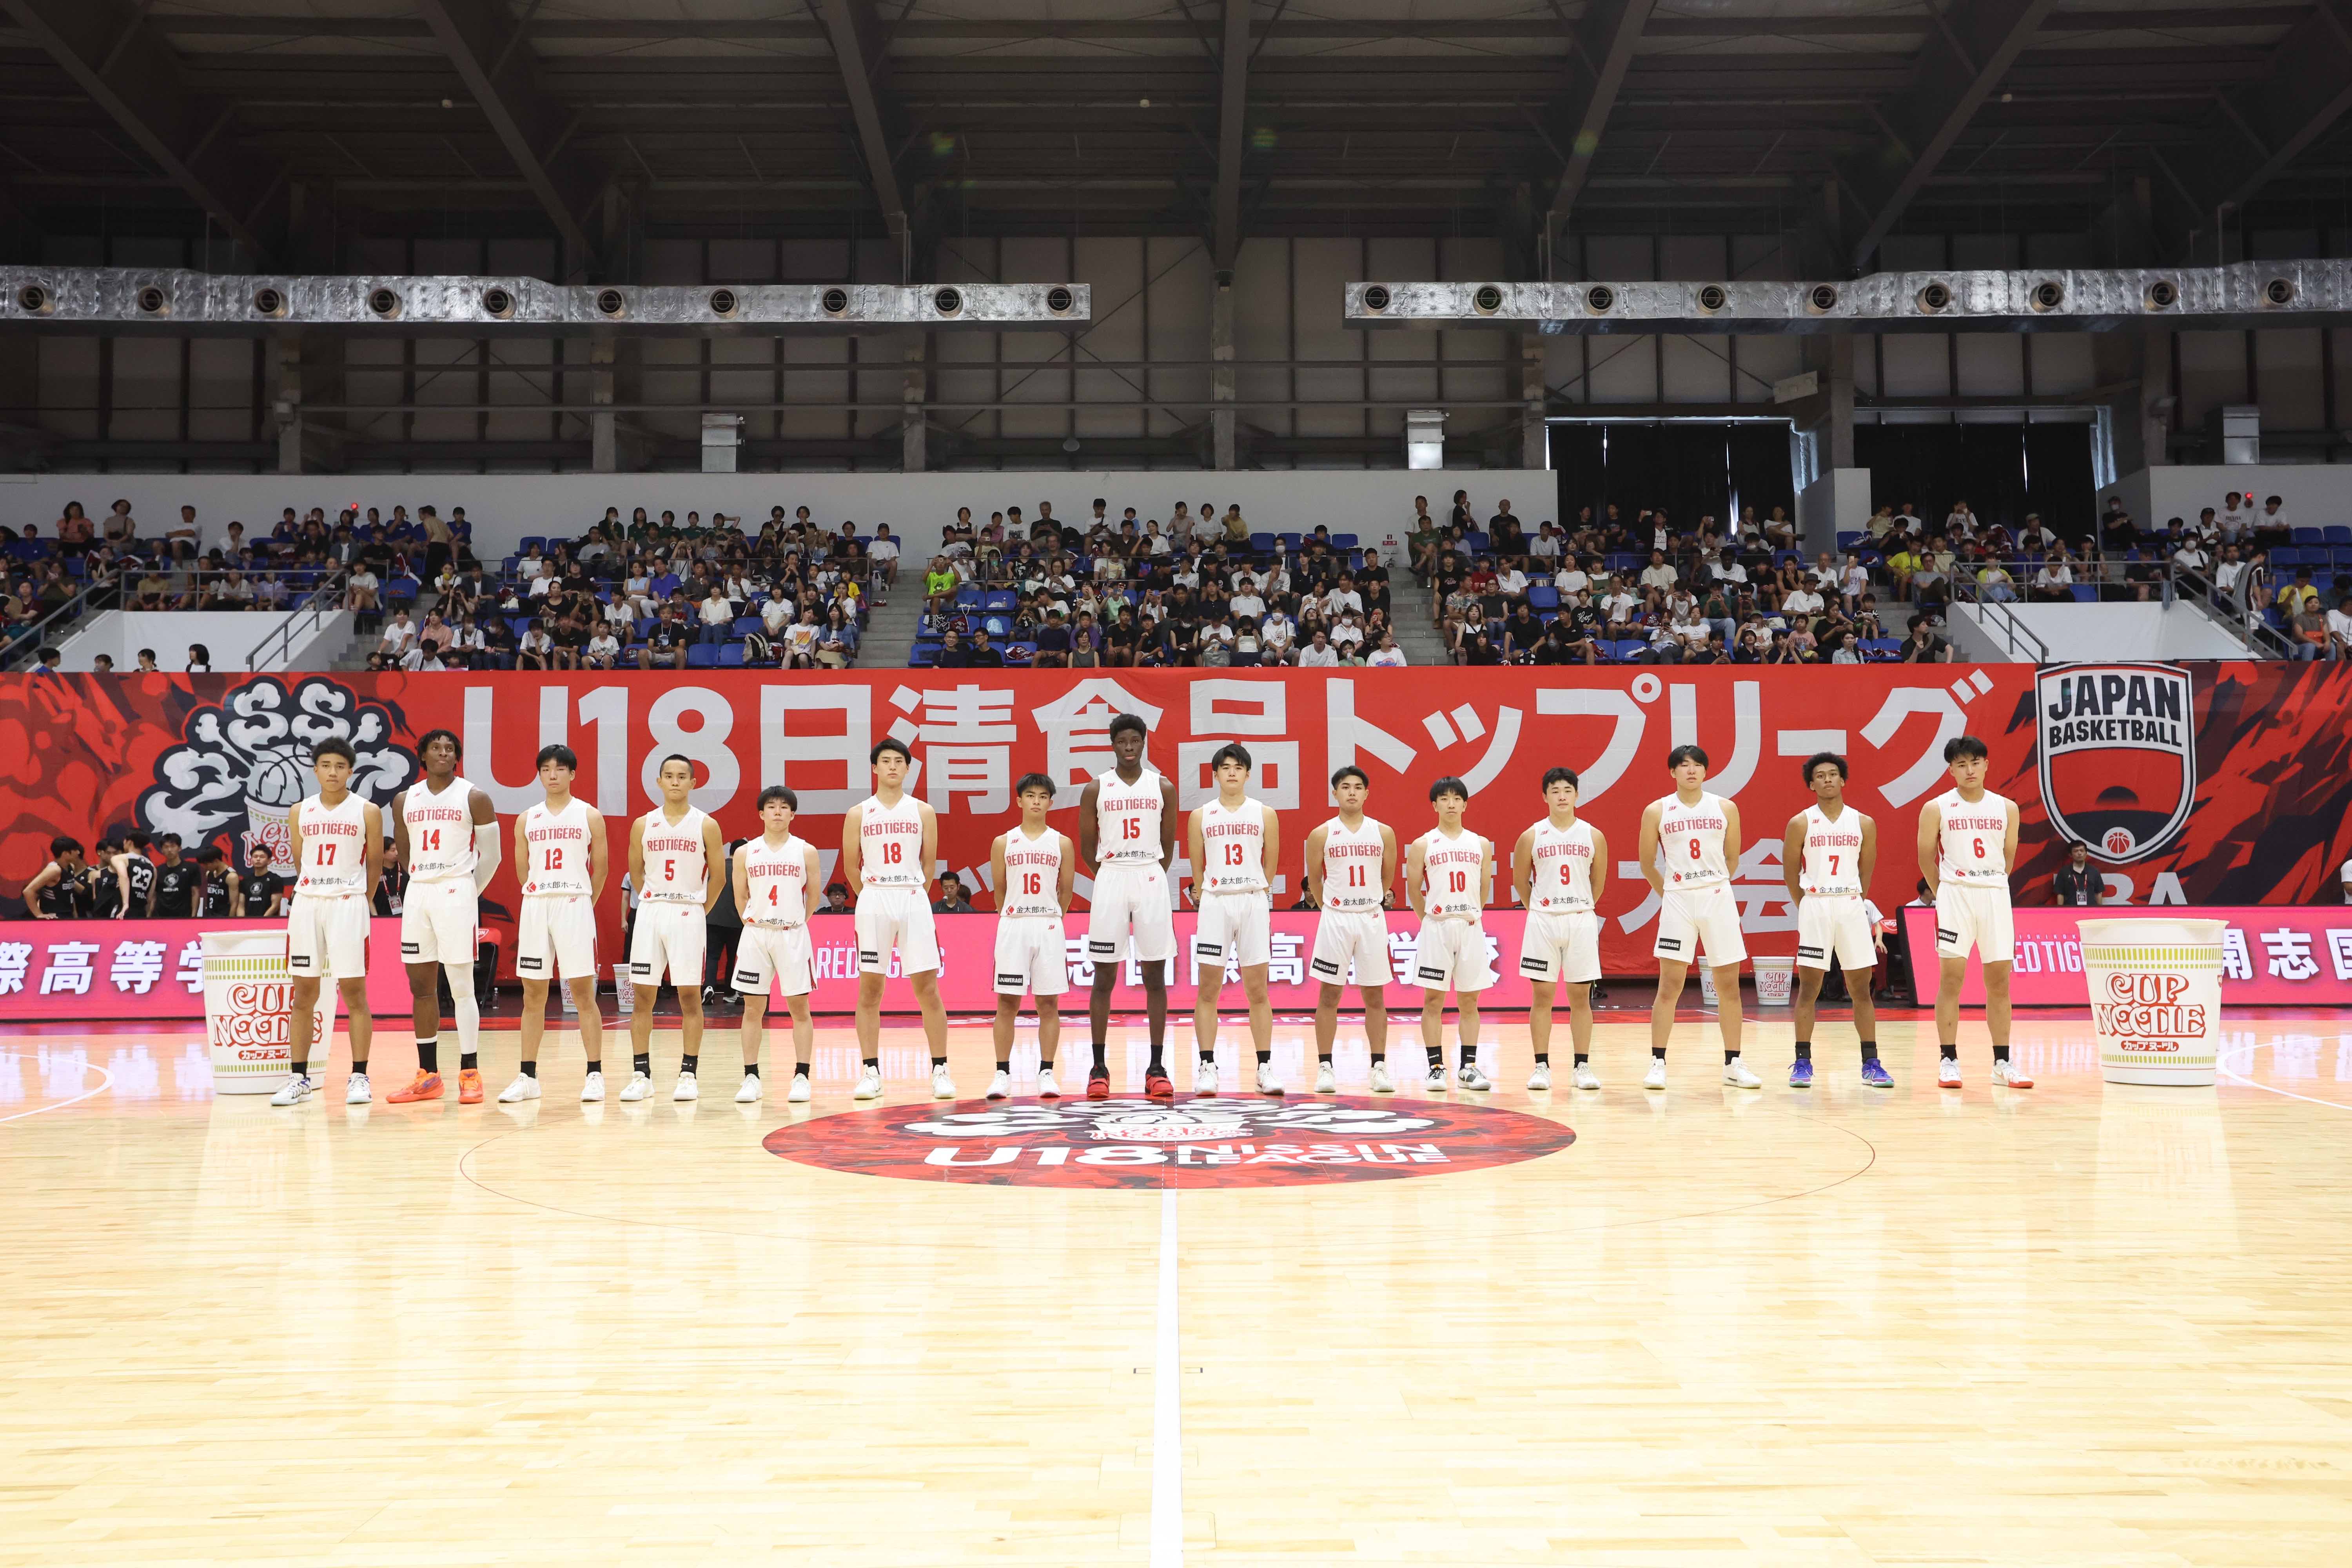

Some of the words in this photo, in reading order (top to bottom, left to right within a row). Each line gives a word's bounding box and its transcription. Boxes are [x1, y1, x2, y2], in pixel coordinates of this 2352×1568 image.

[2049, 675, 2181, 722] JAPAN
[2049, 719, 2182, 748] BASKETBALL
[1104, 799, 1122, 812] RED
[1125, 799, 1157, 810] TIGERS
[407, 809, 424, 823] RED
[426, 809, 461, 821] TIGERS
[1948, 819, 1967, 831] RED
[1969, 819, 2002, 830] TIGERS
[302, 824, 319, 837] RED
[322, 823, 358, 836] TIGERS
[529, 829, 546, 842] RED
[548, 828, 581, 839] TIGERS
[863, 824, 882, 837] RED
[884, 822, 918, 835] TIGERS
[1123, 818, 1140, 839] 15
[1206, 825, 1224, 838] RED
[1226, 824, 1259, 836] TIGERS
[1664, 821, 1684, 835] RED
[1686, 819, 1722, 830] TIGERS
[423, 829, 439, 851] 14
[647, 839, 664, 852] RED
[666, 839, 696, 853] TIGERS
[1690, 839, 1700, 859] 8
[1810, 836, 1825, 847] RED
[1827, 835, 1858, 847] TIGERS
[1974, 838, 1985, 858] 6
[317, 844, 336, 866] 17
[546, 848, 563, 870] 12
[884, 842, 902, 864] 18
[1007, 854, 1023, 867] RED
[1025, 853, 1057, 867] TIGERS
[1225, 844, 1243, 865] 13
[1329, 846, 1348, 858] RED
[1350, 845, 1381, 857] TIGERS
[1430, 853, 1448, 866] RED
[1449, 851, 1480, 865] TIGERS
[1537, 846, 1555, 858] RED
[1557, 844, 1590, 858] TIGERS
[665, 860, 675, 881] 5
[748, 866, 766, 878] RED
[768, 864, 800, 877] TIGERS
[1561, 864, 1570, 885] 9
[1829, 855, 1839, 875] 7
[132, 866, 152, 891] 23
[1024, 873, 1040, 895] 16
[1349, 866, 1365, 887] 11
[1450, 871, 1465, 893] 10
[769, 885, 777, 906] 4
[816, 947, 859, 979] RED
[1759, 982, 1790, 992] NOODLE
[1764, 972, 1788, 982] CUP
[2106, 973, 2189, 1005] CUP
[2094, 1003, 2206, 1038] NOODLE
[2123, 1041, 2177, 1052] カップヌードル
[924, 1145, 1169, 1166] U18
[1177, 1143, 1443, 1154] NISSIN
[1177, 1154, 1452, 1163] LEAGUE
